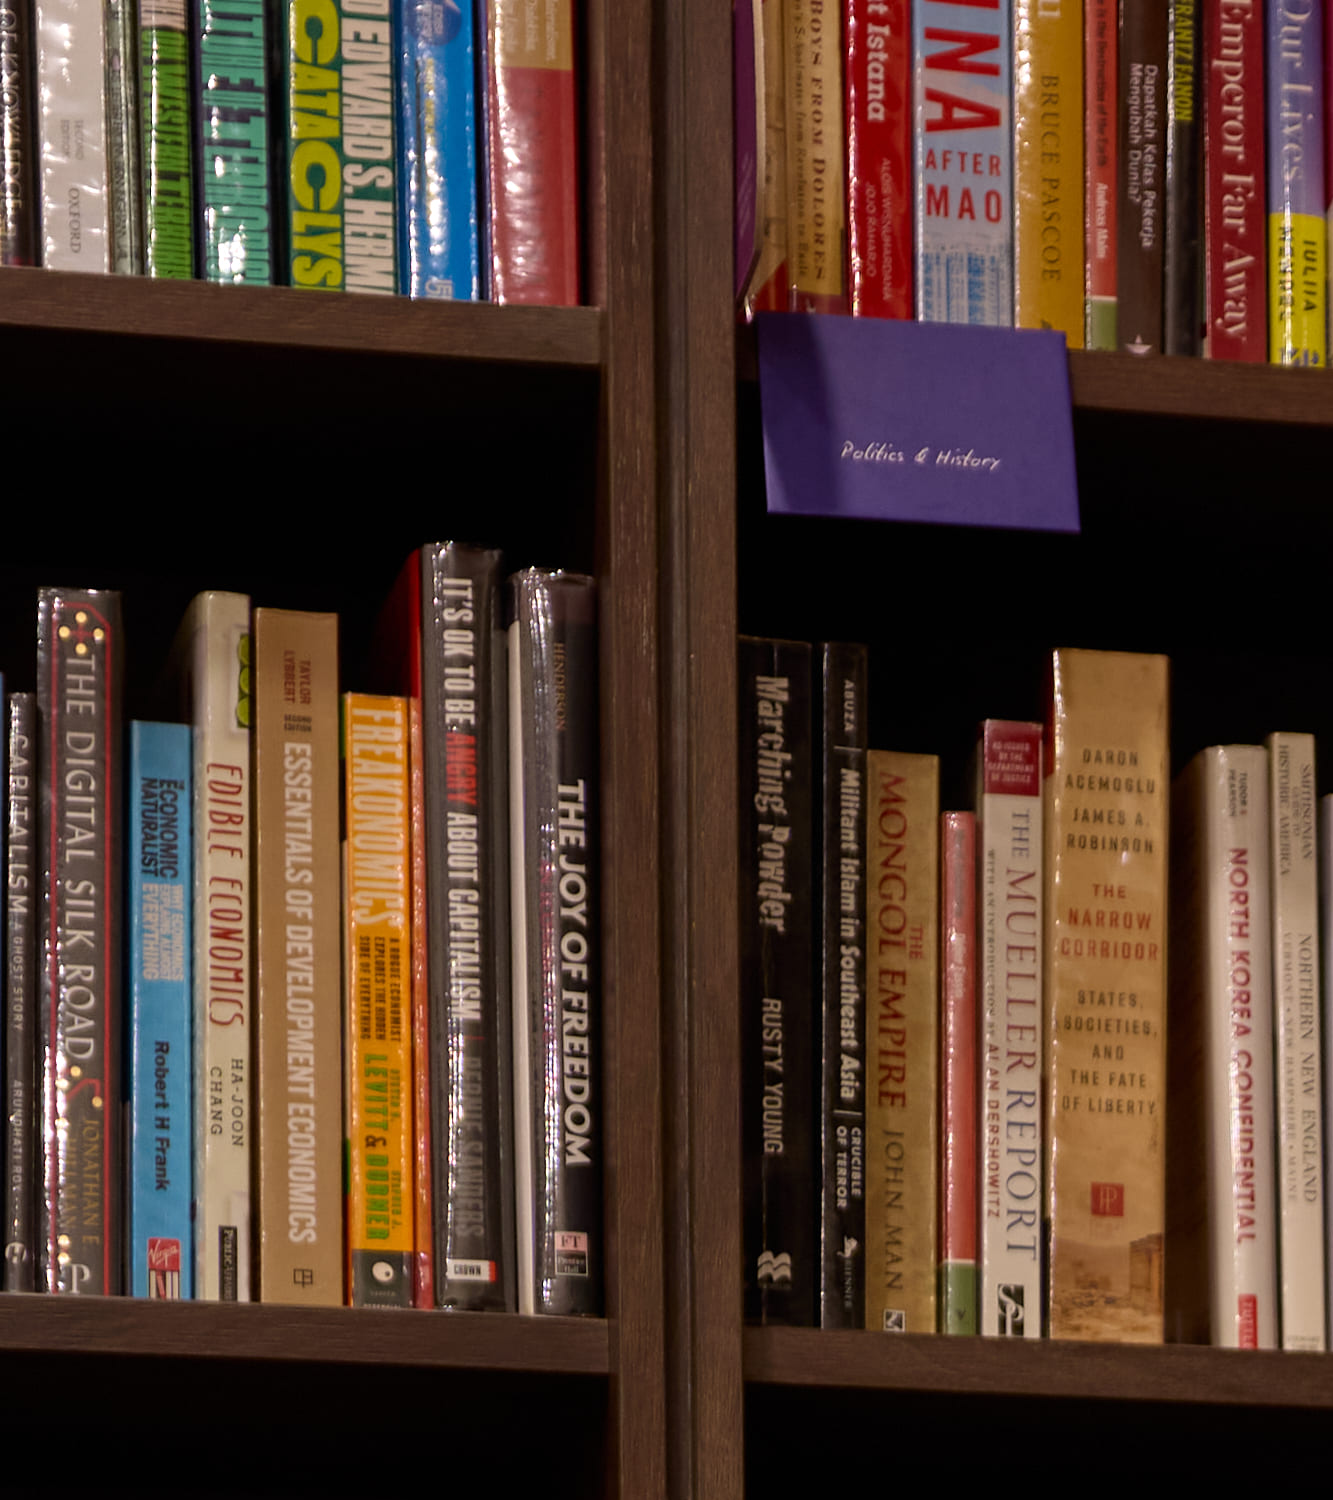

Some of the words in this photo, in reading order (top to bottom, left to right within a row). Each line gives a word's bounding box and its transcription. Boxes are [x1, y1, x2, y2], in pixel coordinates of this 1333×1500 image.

[343, 18, 394, 158] EDWARD
[1041, 75, 1060, 165] BRUCE
[1124, 63, 1142, 145] Mengubah
[1141, 64, 1158, 138] Dapatkah
[343, 163, 392, 196] S.
[925, 152, 1001, 176] AFTER
[1127, 150, 1143, 203] Dunia?
[1141, 143, 1157, 184] Kelas
[926, 186, 1003, 223] MAO
[1041, 176, 1061, 283] PASCOE
[1138, 190, 1157, 248] Pekerja
[1219, 173, 1256, 236] Far
[1213, 243, 1252, 341] Away
[841, 440, 904, 463] Politics
[914, 446, 929, 464] &
[936, 449, 1001, 471] History
[444, 578, 474, 621] IT'S
[445, 629, 474, 660] OK
[445, 666, 475, 692] TO
[446, 697, 476, 724] BE
[750, 675, 790, 812] Marching
[446, 732, 477, 805] ANGRY
[284, 742, 313, 885] ESSENTIALS
[352, 707, 405, 927] FREAKONOMICS
[447, 811, 479, 881] ABOUT
[558, 779, 584, 846] THE
[1010, 811, 1030, 857] THE
[559, 856, 586, 920] JOY
[754, 823, 791, 932] Powder
[875, 770, 907, 953] MONGOL
[285, 889, 313, 919] OF
[448, 888, 482, 1020] CAPITALISM
[561, 931, 588, 979] OF
[1005, 868, 1038, 1071] MUELLER
[284, 924, 315, 1096] DEVELOPMENT
[761, 998, 782, 1069] RUSTY
[877, 968, 907, 1107] EMPIRE
[154, 1041, 172, 1109] Robert
[562, 989, 590, 1165] FREEDOM
[155, 1115, 171, 1131] H
[761, 1080, 784, 1153] YOUNG
[155, 1136, 172, 1190] Frank
[288, 1102, 316, 1242] ECONOMICS
[1005, 1089, 1040, 1260] REPORT
